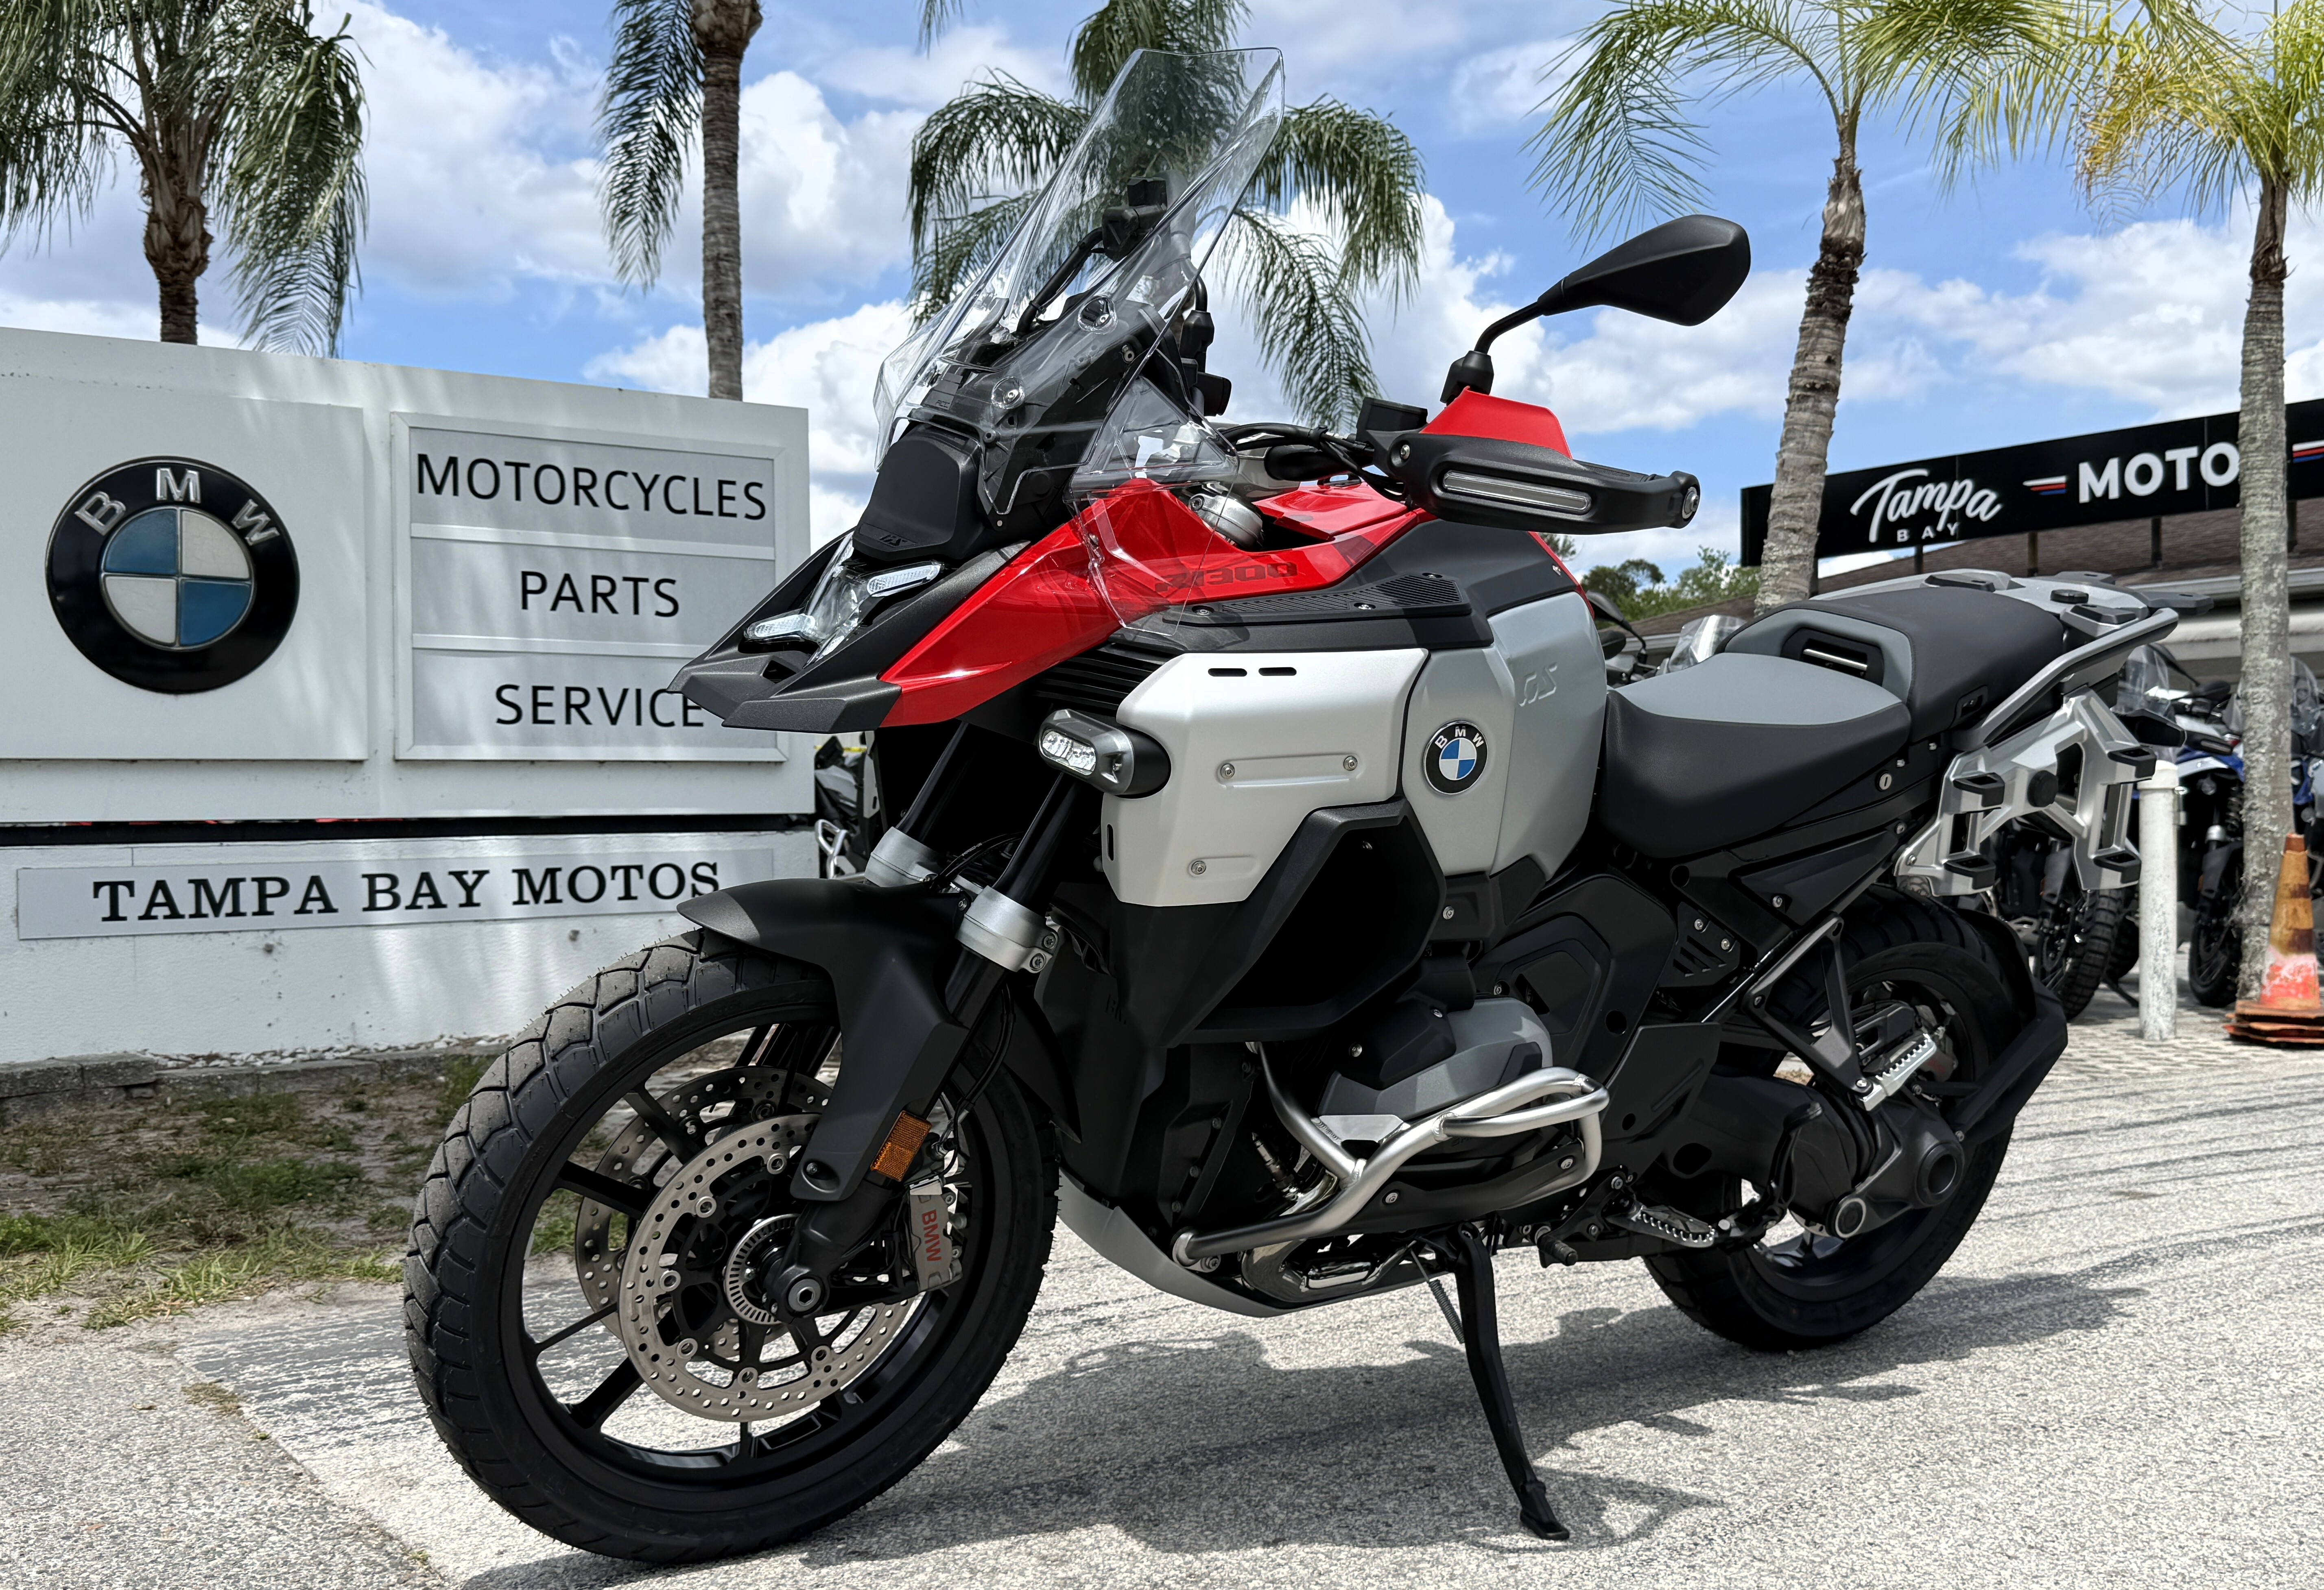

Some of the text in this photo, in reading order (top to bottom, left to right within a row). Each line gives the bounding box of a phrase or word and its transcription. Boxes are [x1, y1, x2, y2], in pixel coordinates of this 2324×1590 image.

[75, 467, 280, 546] BMW
[417, 453, 766, 521] MOTORCYCLES
[1850, 468, 2003, 543] Tampa
[1896, 522, 1959, 543] BAY
[521, 570, 679, 618] PARTS
[496, 684, 704, 727] SERVICE
[1434, 726, 1484, 749] BMW
[93, 862, 719, 922] TAMPA BAY MOTOS
[921, 1209, 941, 1262] BMW
